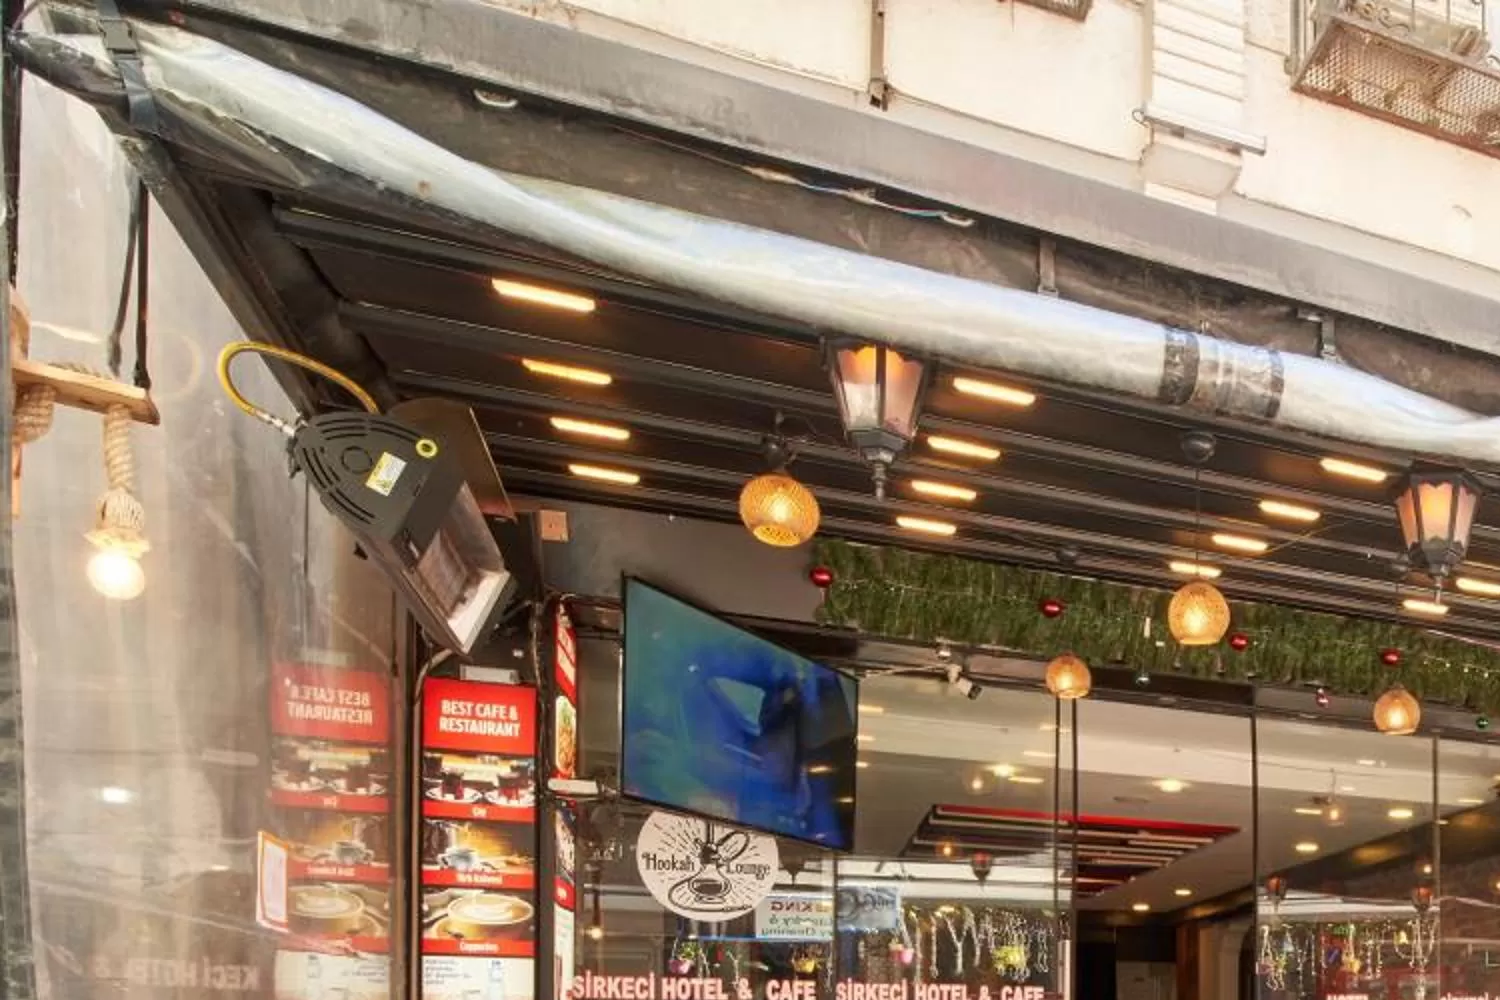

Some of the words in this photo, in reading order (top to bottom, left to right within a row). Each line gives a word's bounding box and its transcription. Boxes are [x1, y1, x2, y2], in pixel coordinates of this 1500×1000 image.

[441, 699, 475, 717] BEST
[475, 703, 507, 720] CAFE
[508, 705, 519, 721] &
[439, 717, 521, 737] RESTAURANT
[641, 852, 695, 871] Hookah
[726, 861, 771, 880] Lounge
[573, 969, 655, 1000] SİRKECİ
[662, 976, 729, 1000] HOTEL
[738, 978, 752, 1000] &
